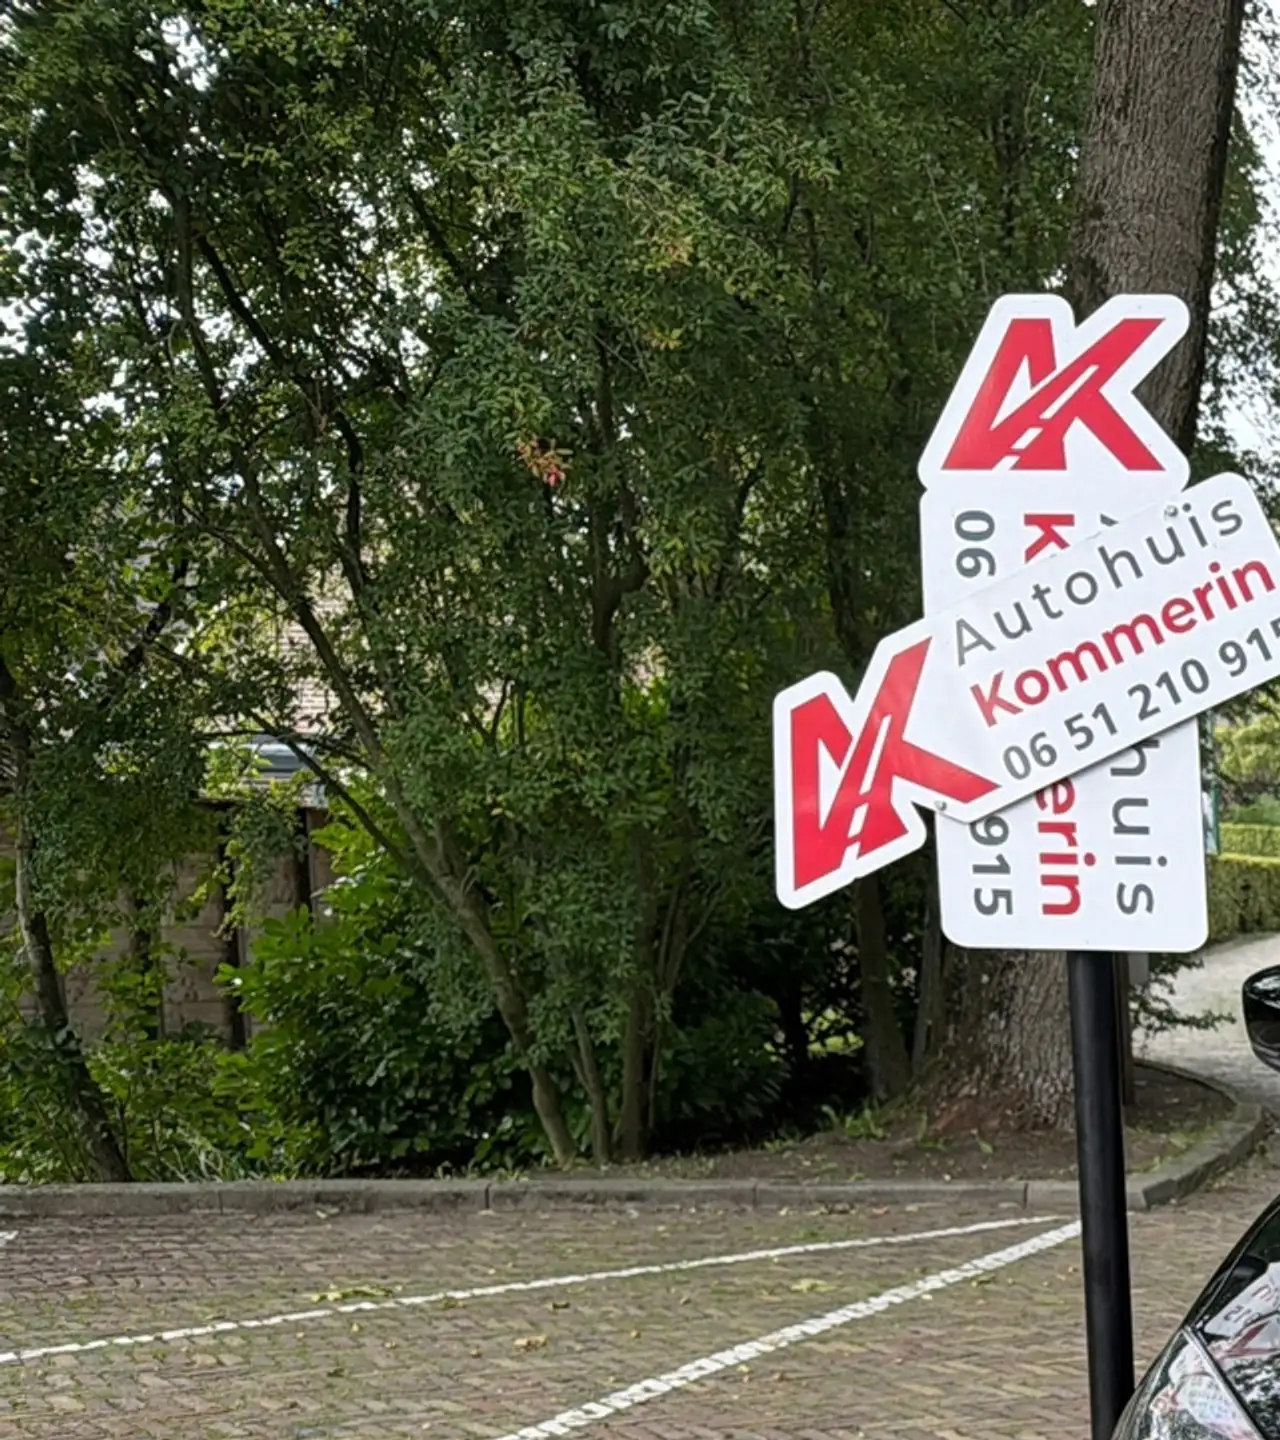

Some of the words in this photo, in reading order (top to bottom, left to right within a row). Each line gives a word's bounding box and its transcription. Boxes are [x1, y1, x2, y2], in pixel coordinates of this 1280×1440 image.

[942, 319, 1166, 471] AK
[954, 510, 997, 578] 06
[955, 499, 1243, 667] Autohuis
[969, 559, 1277, 728] Kommerin
[1002, 731, 1058, 781] 06
[1063, 702, 1118, 751] 51
[1127, 658, 1210, 722] 210
[790, 636, 1002, 892] AK
[970, 815, 1014, 916] 915
